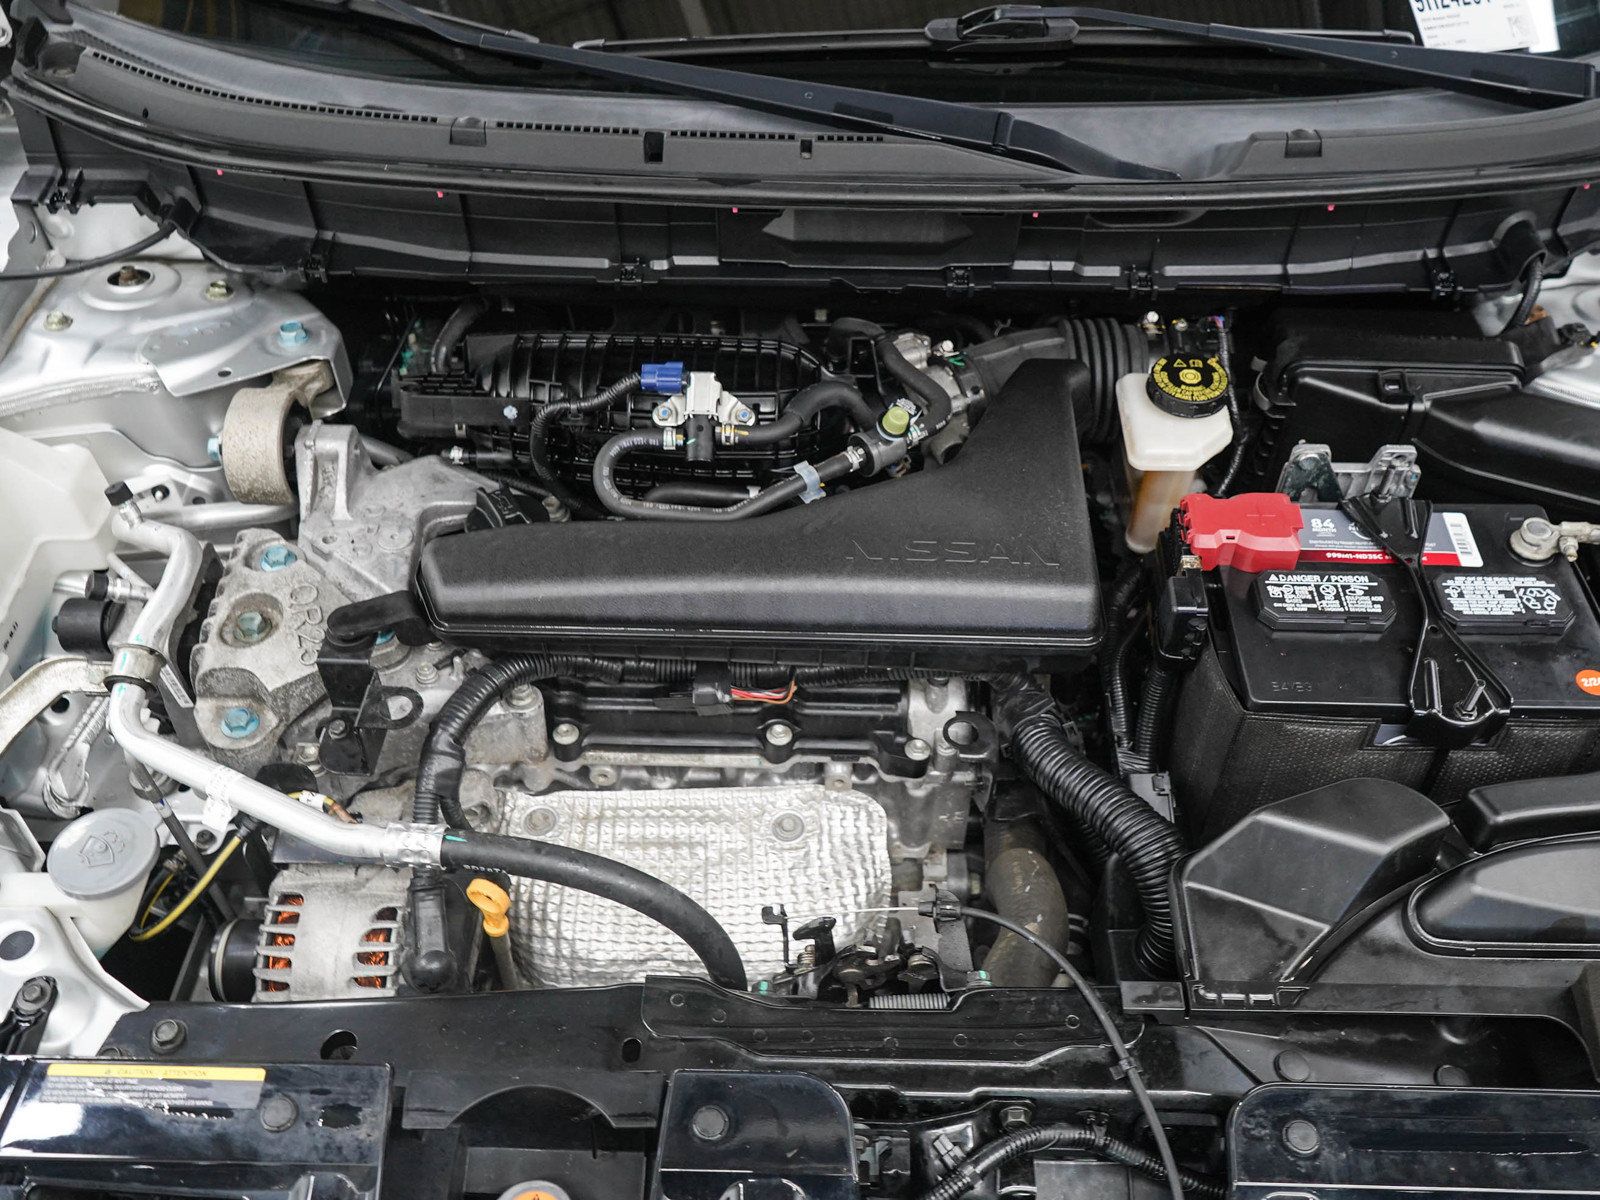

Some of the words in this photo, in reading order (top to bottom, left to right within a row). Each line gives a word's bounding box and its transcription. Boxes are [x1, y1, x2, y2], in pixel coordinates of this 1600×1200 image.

[1311, 518, 1335, 528] 84
[845, 539, 1060, 566] NISSAN
[1278, 574, 1321, 583] DANGER
[1330, 575, 1370, 583] POISON
